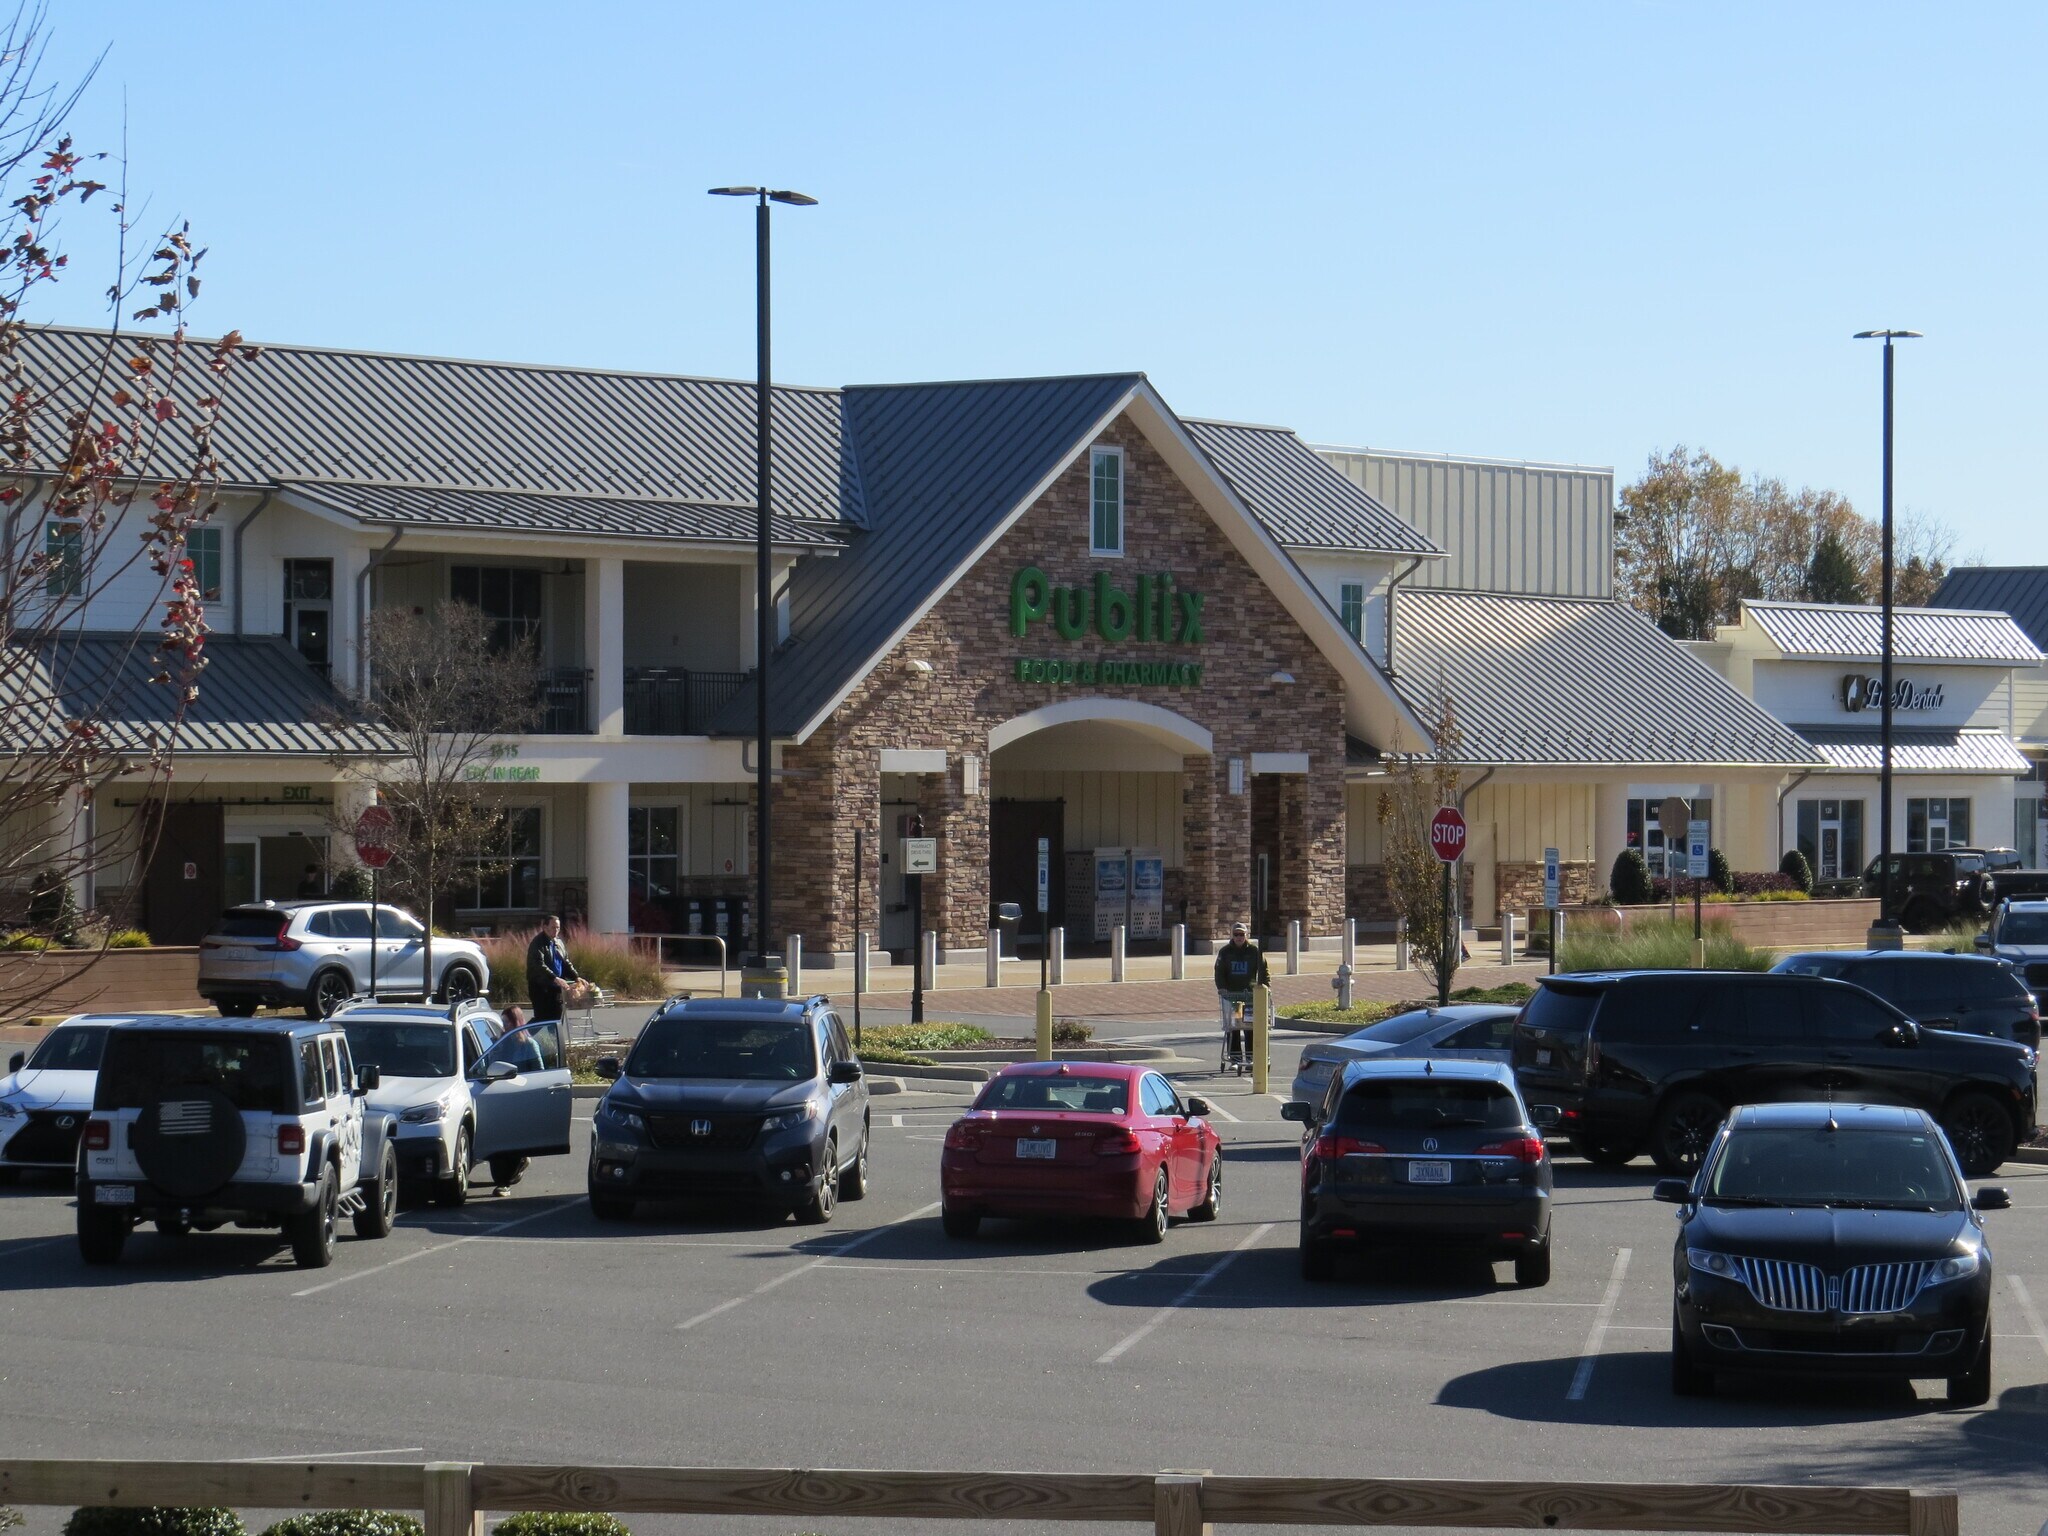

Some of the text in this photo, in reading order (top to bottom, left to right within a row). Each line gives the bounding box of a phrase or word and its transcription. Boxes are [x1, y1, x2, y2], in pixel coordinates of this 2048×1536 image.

[1010, 566, 1205, 642] Publix
[1016, 659, 1203, 686] FOOD & PHARMACY
[1896, 678, 1943, 710] Dental
[493, 766, 506, 780] IN
[509, 766, 540, 780] REAR
[282, 786, 312, 800] EXIT
[1433, 823, 1464, 844] STOP
